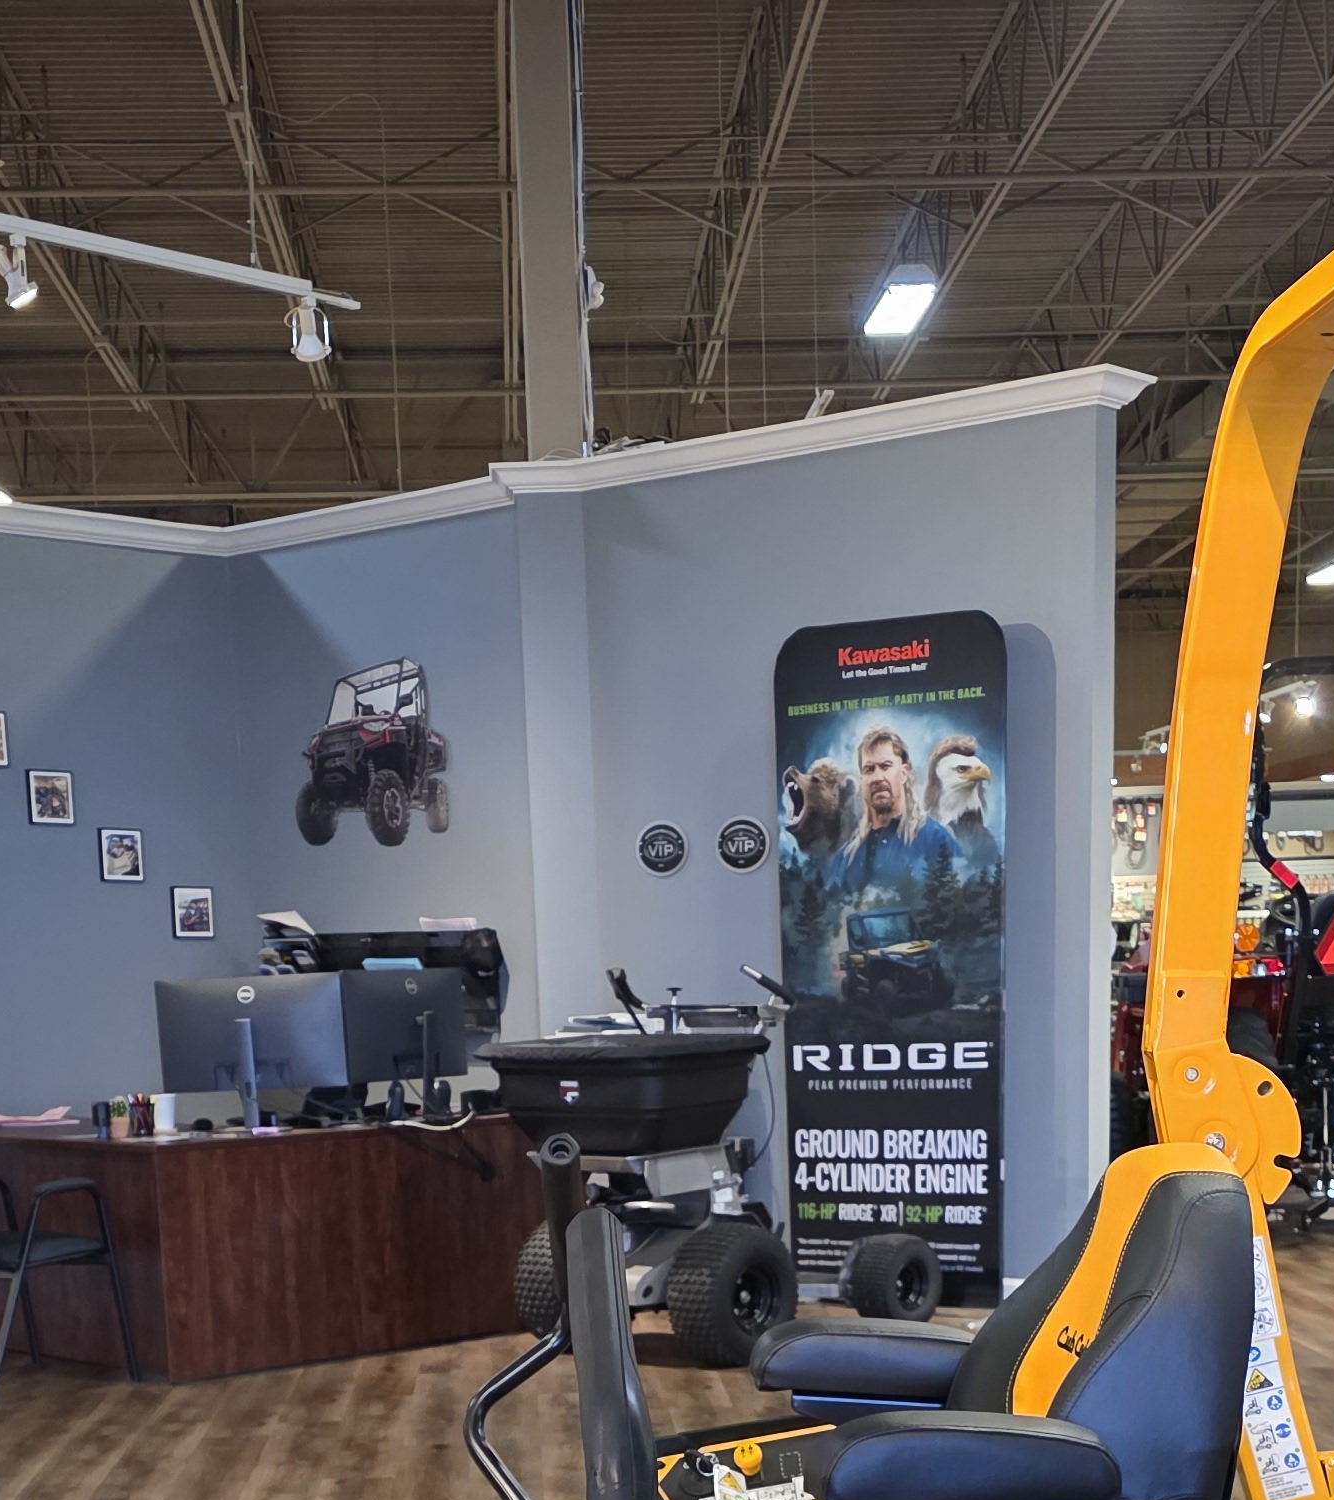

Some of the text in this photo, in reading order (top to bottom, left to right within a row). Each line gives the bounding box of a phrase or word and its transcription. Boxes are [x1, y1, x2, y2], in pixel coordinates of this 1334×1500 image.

[837, 638, 930, 667] Kawasaki
[841, 670, 854, 679] Let
[854, 668, 867, 678] the
[867, 666, 888, 677] Good
[888, 665, 910, 675] Times
[787, 686, 986, 717] BUSINESS IN THE FRONT. PARTY IN THE BACK.
[648, 844, 674, 857] VIP
[727, 839, 755, 853] VIP
[808, 1077, 973, 1091] PEAK PREMIUM PERFORMANCE
[794, 1128, 988, 1160] GROUND BREAKING
[794, 1162, 989, 1195] 4-CYLINDER ENGINE
[797, 1202, 837, 1221] 116-HP
[879, 1204, 898, 1223] XR
[906, 1204, 944, 1223] 92-HP
[1056, 1325, 1078, 1354] Cub
